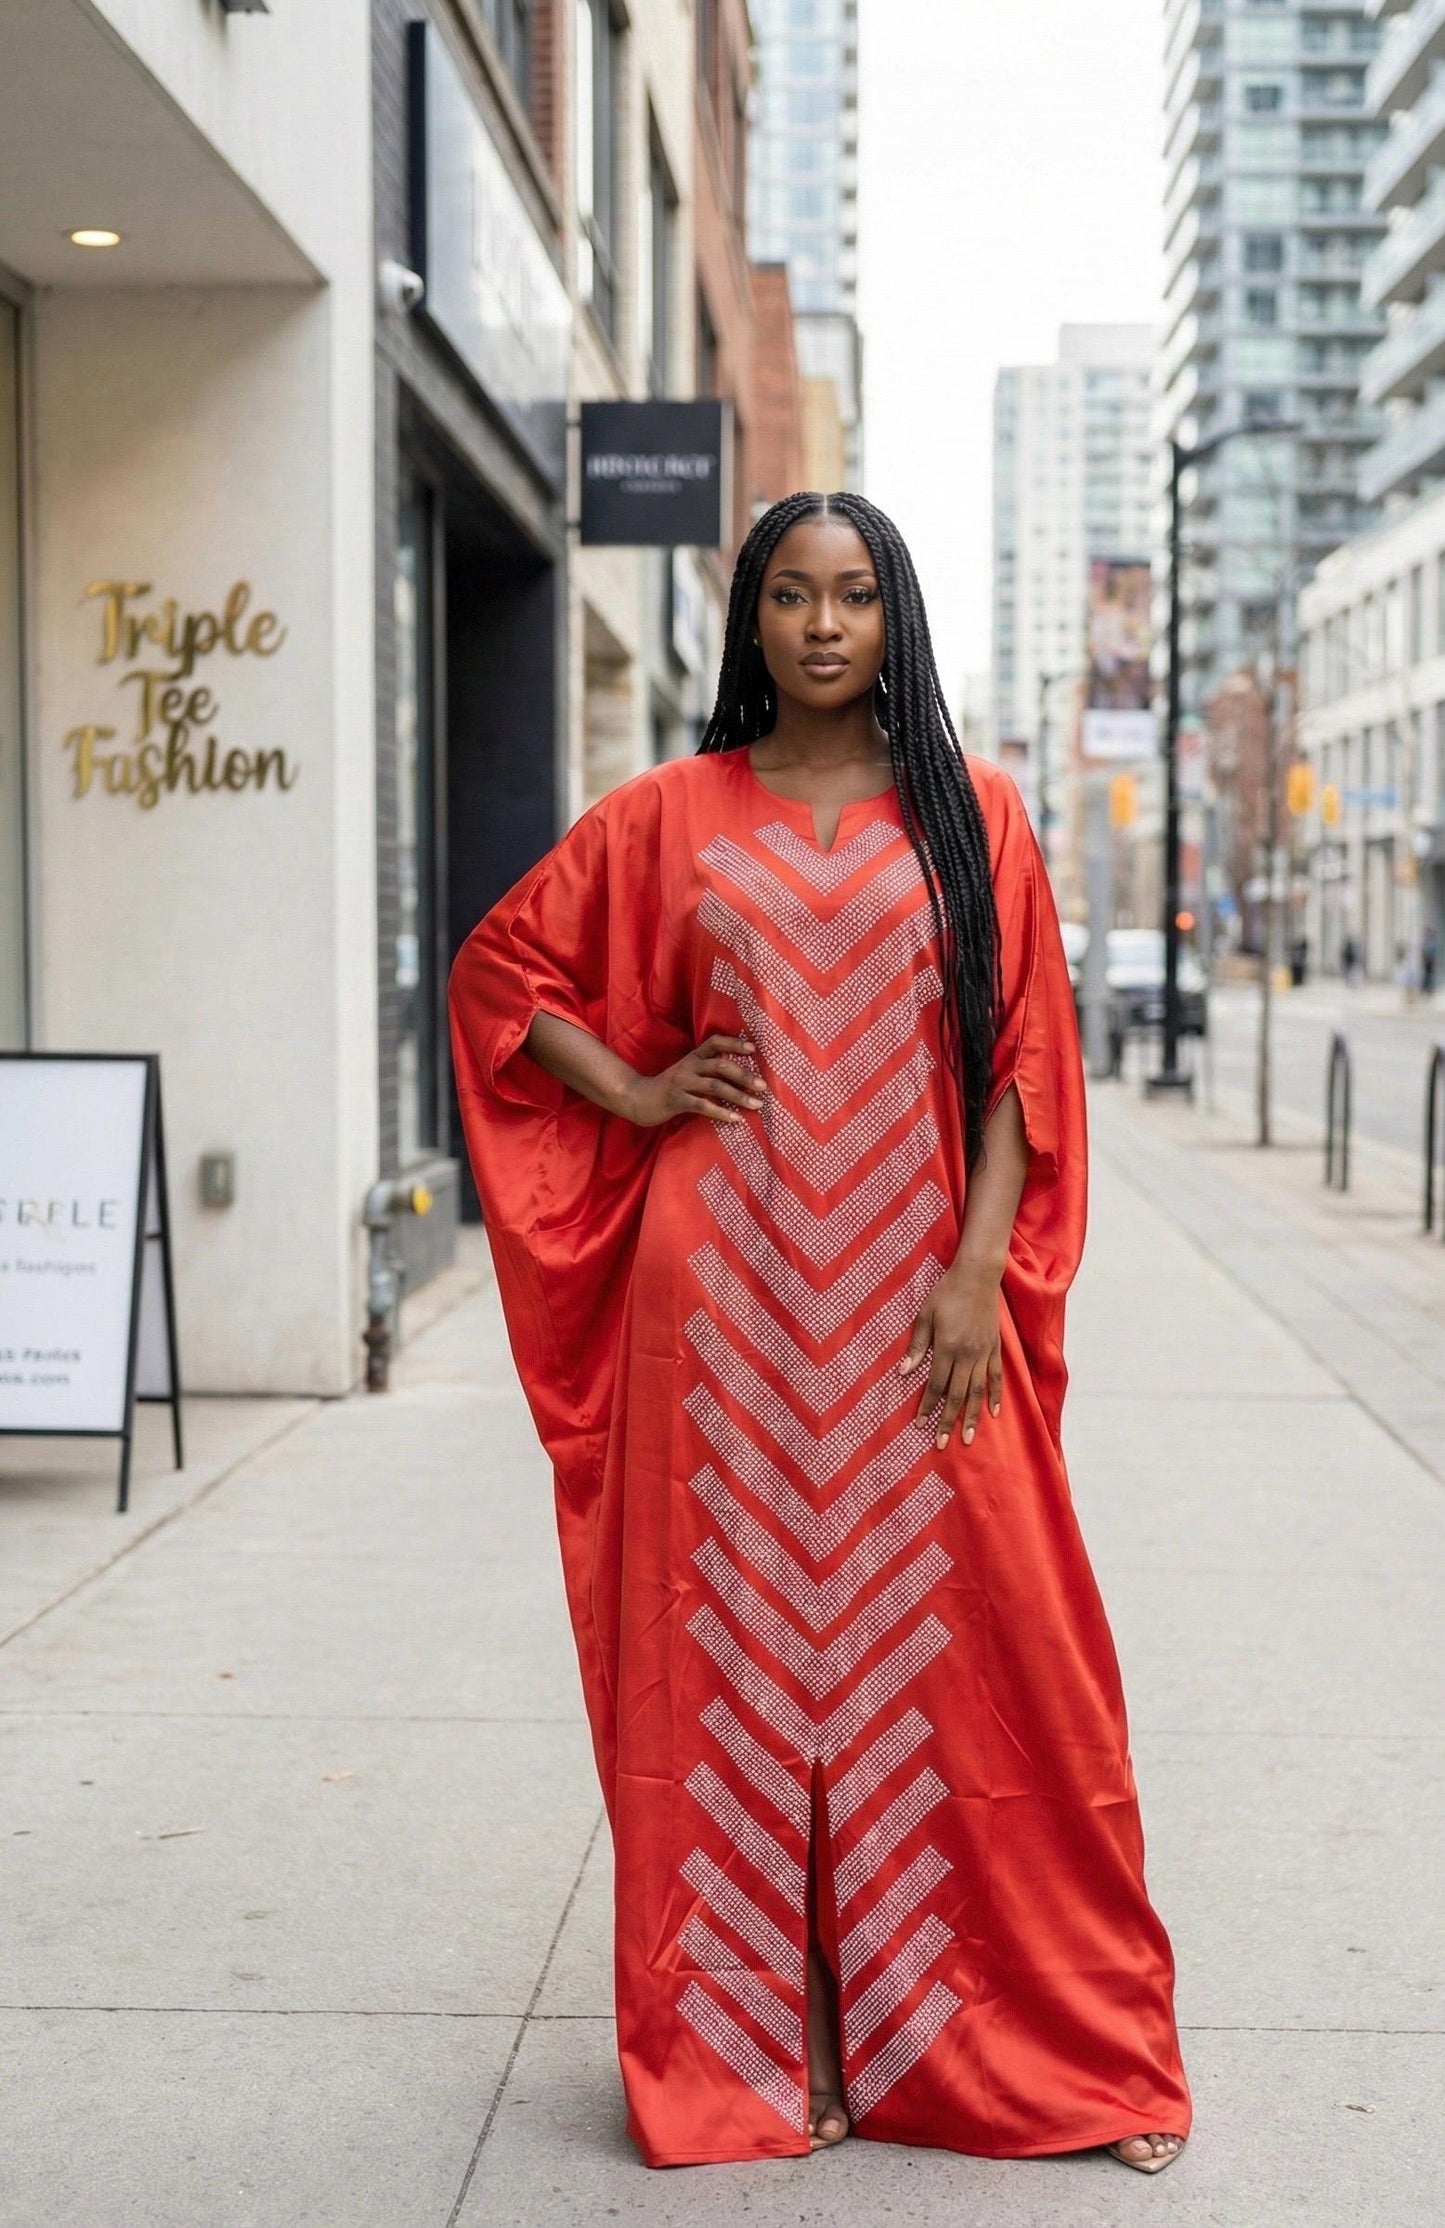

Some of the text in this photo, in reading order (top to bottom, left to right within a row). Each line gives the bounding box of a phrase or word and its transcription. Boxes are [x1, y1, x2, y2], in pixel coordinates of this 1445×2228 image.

[84, 579, 287, 677] Triple
[119, 670, 218, 742] Tee
[63, 722, 298, 810] Fashion
